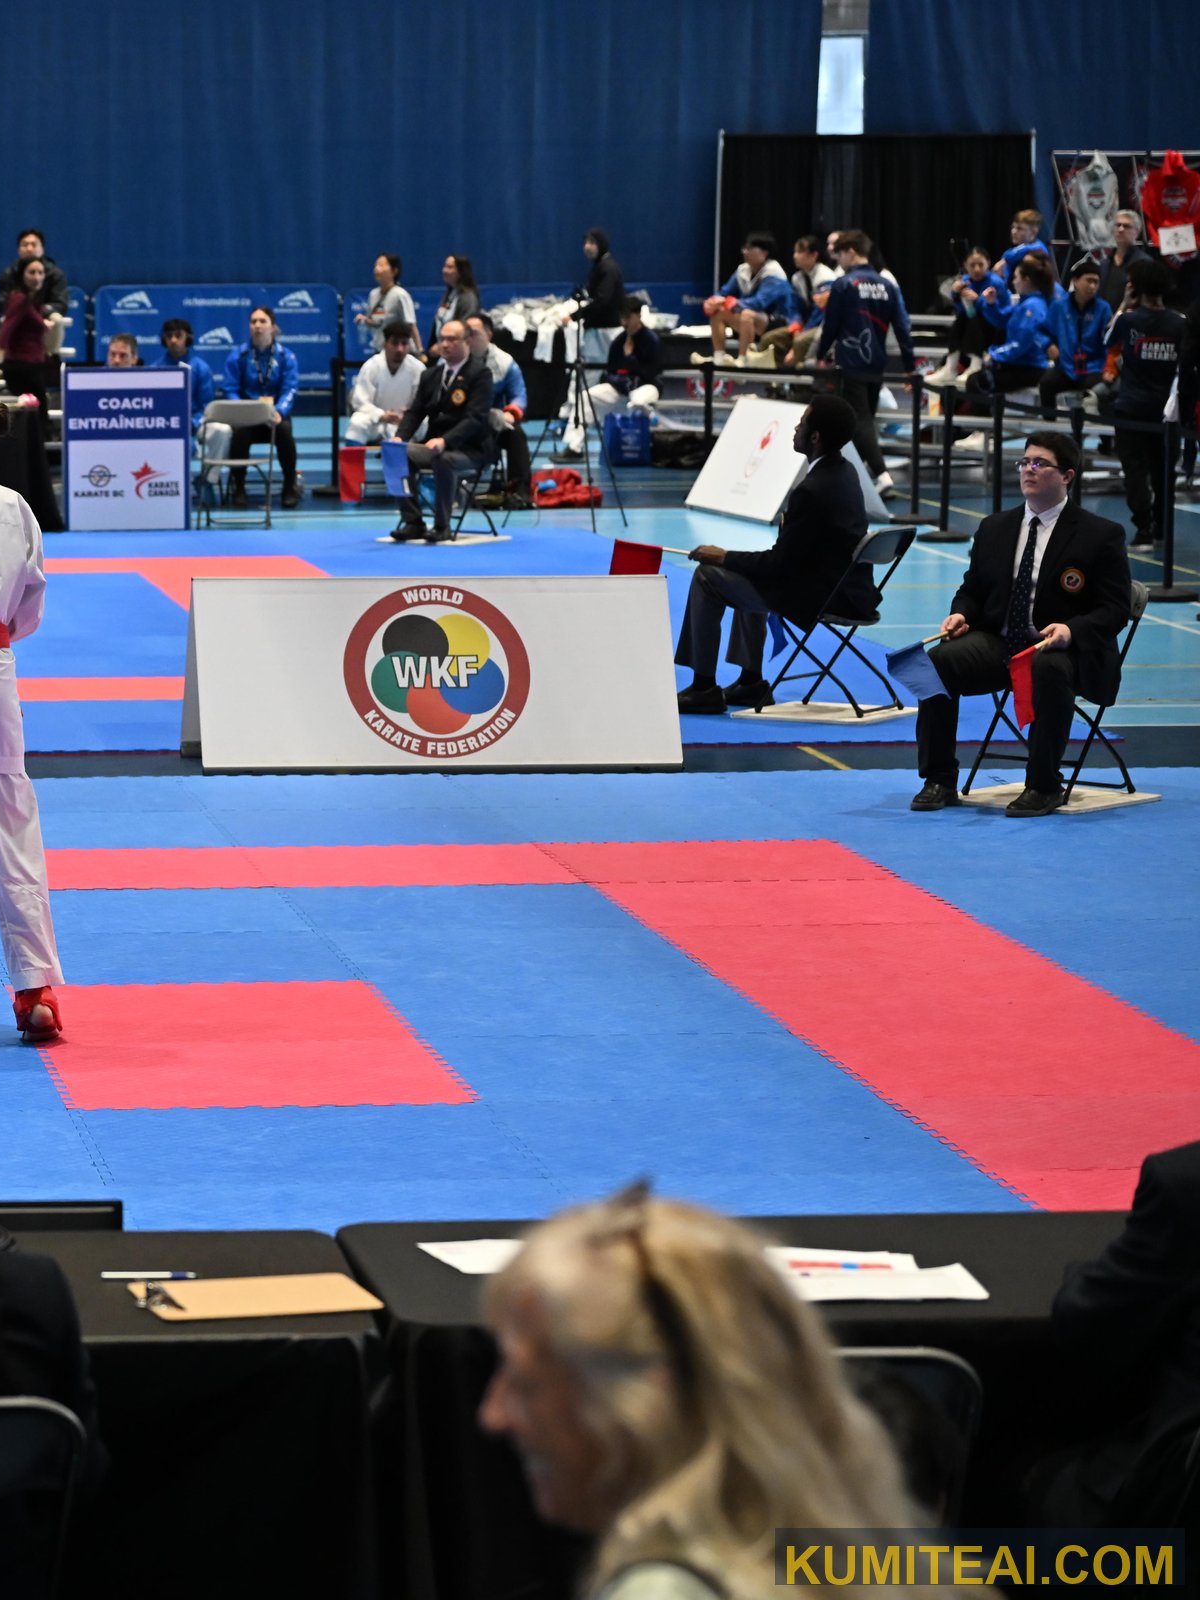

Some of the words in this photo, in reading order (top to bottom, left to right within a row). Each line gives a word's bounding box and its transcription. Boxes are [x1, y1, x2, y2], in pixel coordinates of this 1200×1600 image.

[98, 397, 153, 410] COACH
[148, 480, 180, 488] KARATE
[74, 490, 109, 498] KARATE
[148, 489, 180, 497] CANADA
[402, 588, 464, 605] WORLD
[391, 654, 479, 688] WKF
[364, 709, 422, 752] KARATE
[426, 708, 516, 756] FEDERATION
